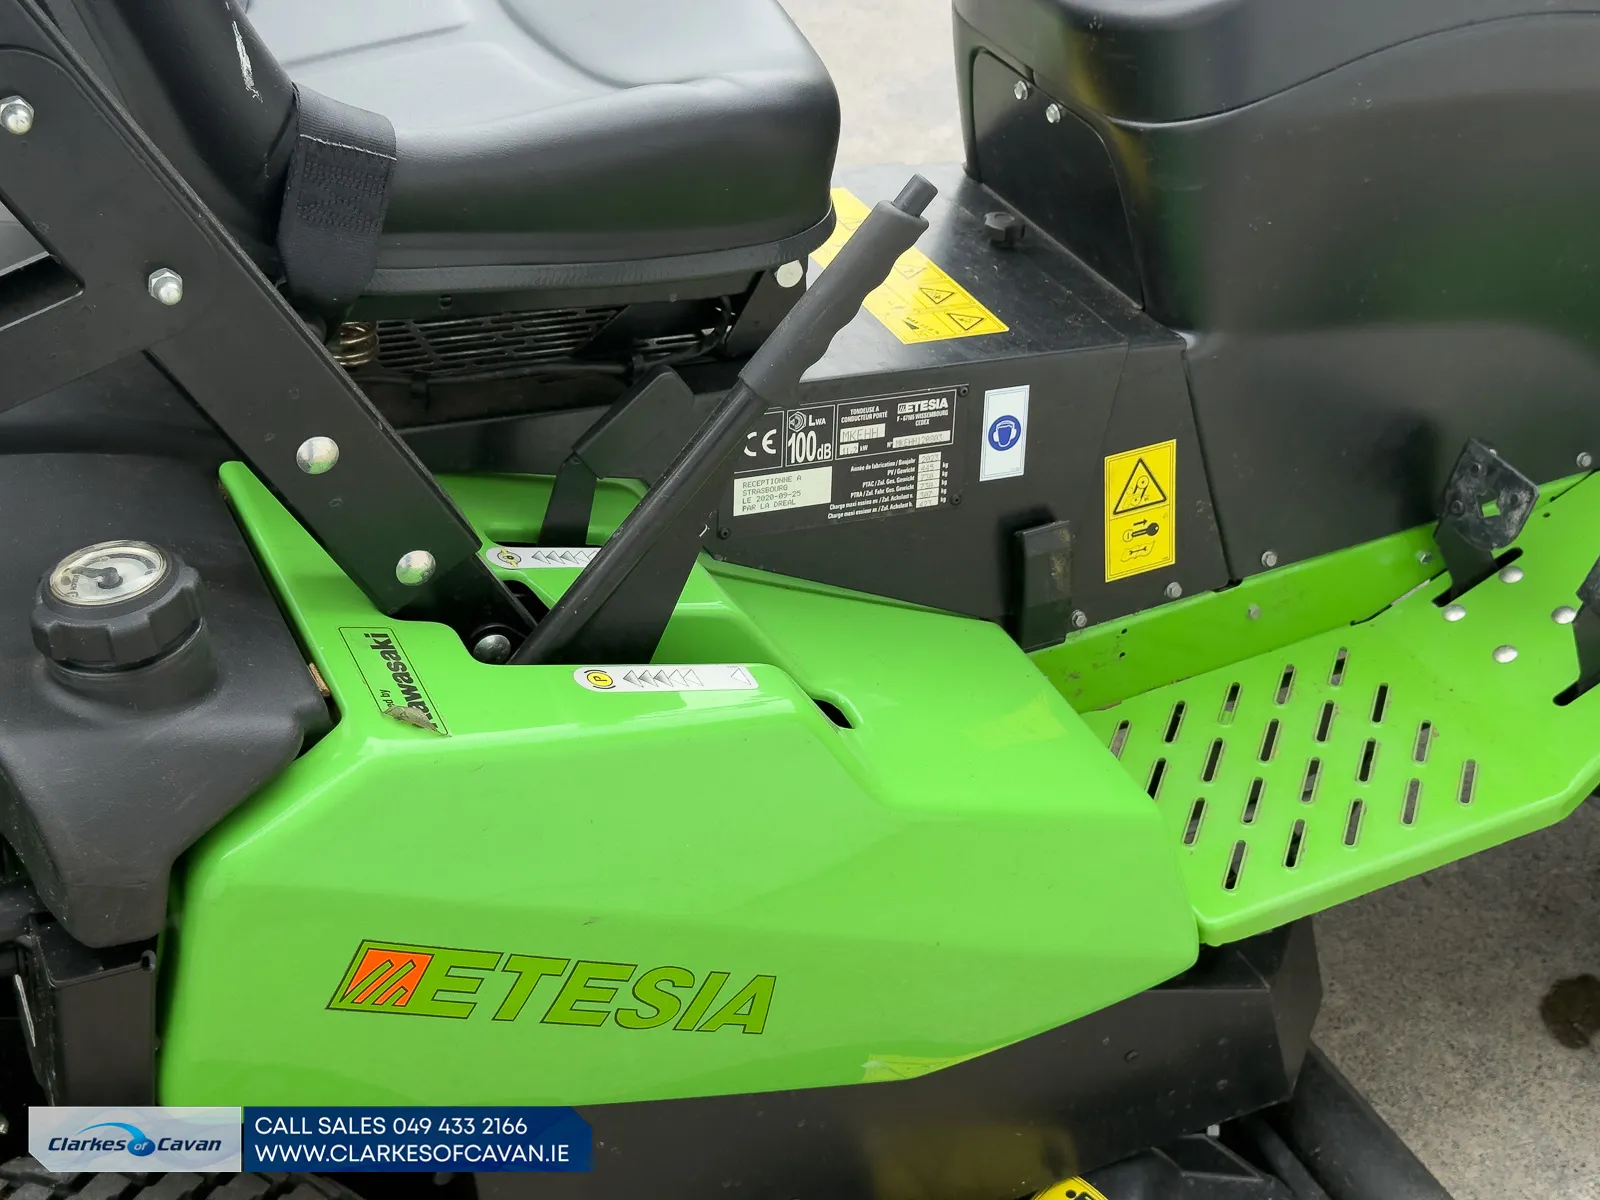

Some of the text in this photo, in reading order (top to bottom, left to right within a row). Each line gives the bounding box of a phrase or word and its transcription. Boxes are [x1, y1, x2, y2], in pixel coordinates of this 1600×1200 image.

[850, 406, 875, 415] TONDEUSE
[898, 398, 948, 414] ETESIA
[841, 410, 888, 423] CONDUCTEUR PORTÉ
[915, 410, 948, 419] WISSEMBOURG
[872, 461, 895, 469] fabrication
[742, 476, 792, 488] RECEPTIONNE
[896, 475, 915, 483] Gewicht
[742, 484, 788, 496] STRASBOURG
[756, 490, 801, 502] 2020-09-25
[851, 491, 862, 499] PTRA
[896, 484, 914, 492] Gewicht
[773, 499, 796, 508] DREAL
[364, 633, 438, 729] awasaki
[380, 689, 390, 697] by
[326, 939, 777, 1035] ETESIA
